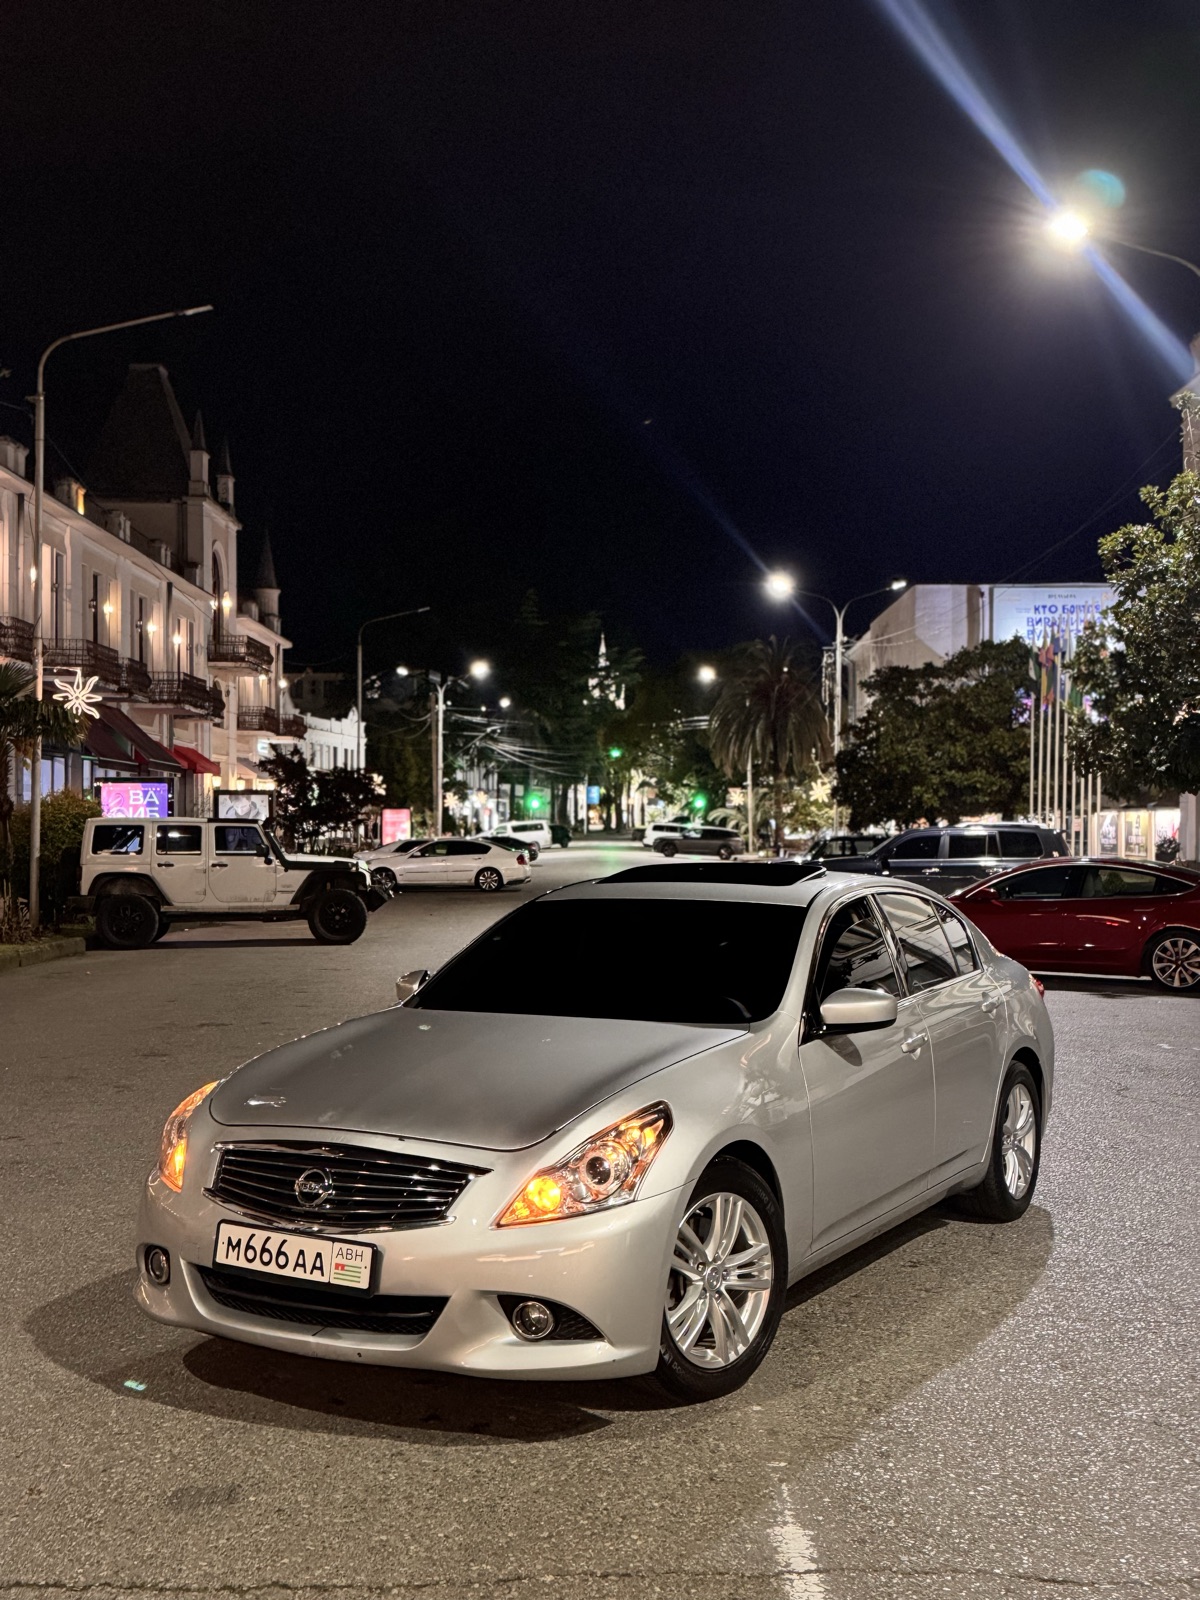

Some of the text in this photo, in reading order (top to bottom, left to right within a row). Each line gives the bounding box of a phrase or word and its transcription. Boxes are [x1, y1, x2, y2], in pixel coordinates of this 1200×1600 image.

[1034, 604, 1058, 614] КТО
[129, 790, 159, 805] ВА
[226, 1233, 364, 1277] M666AA ABH
